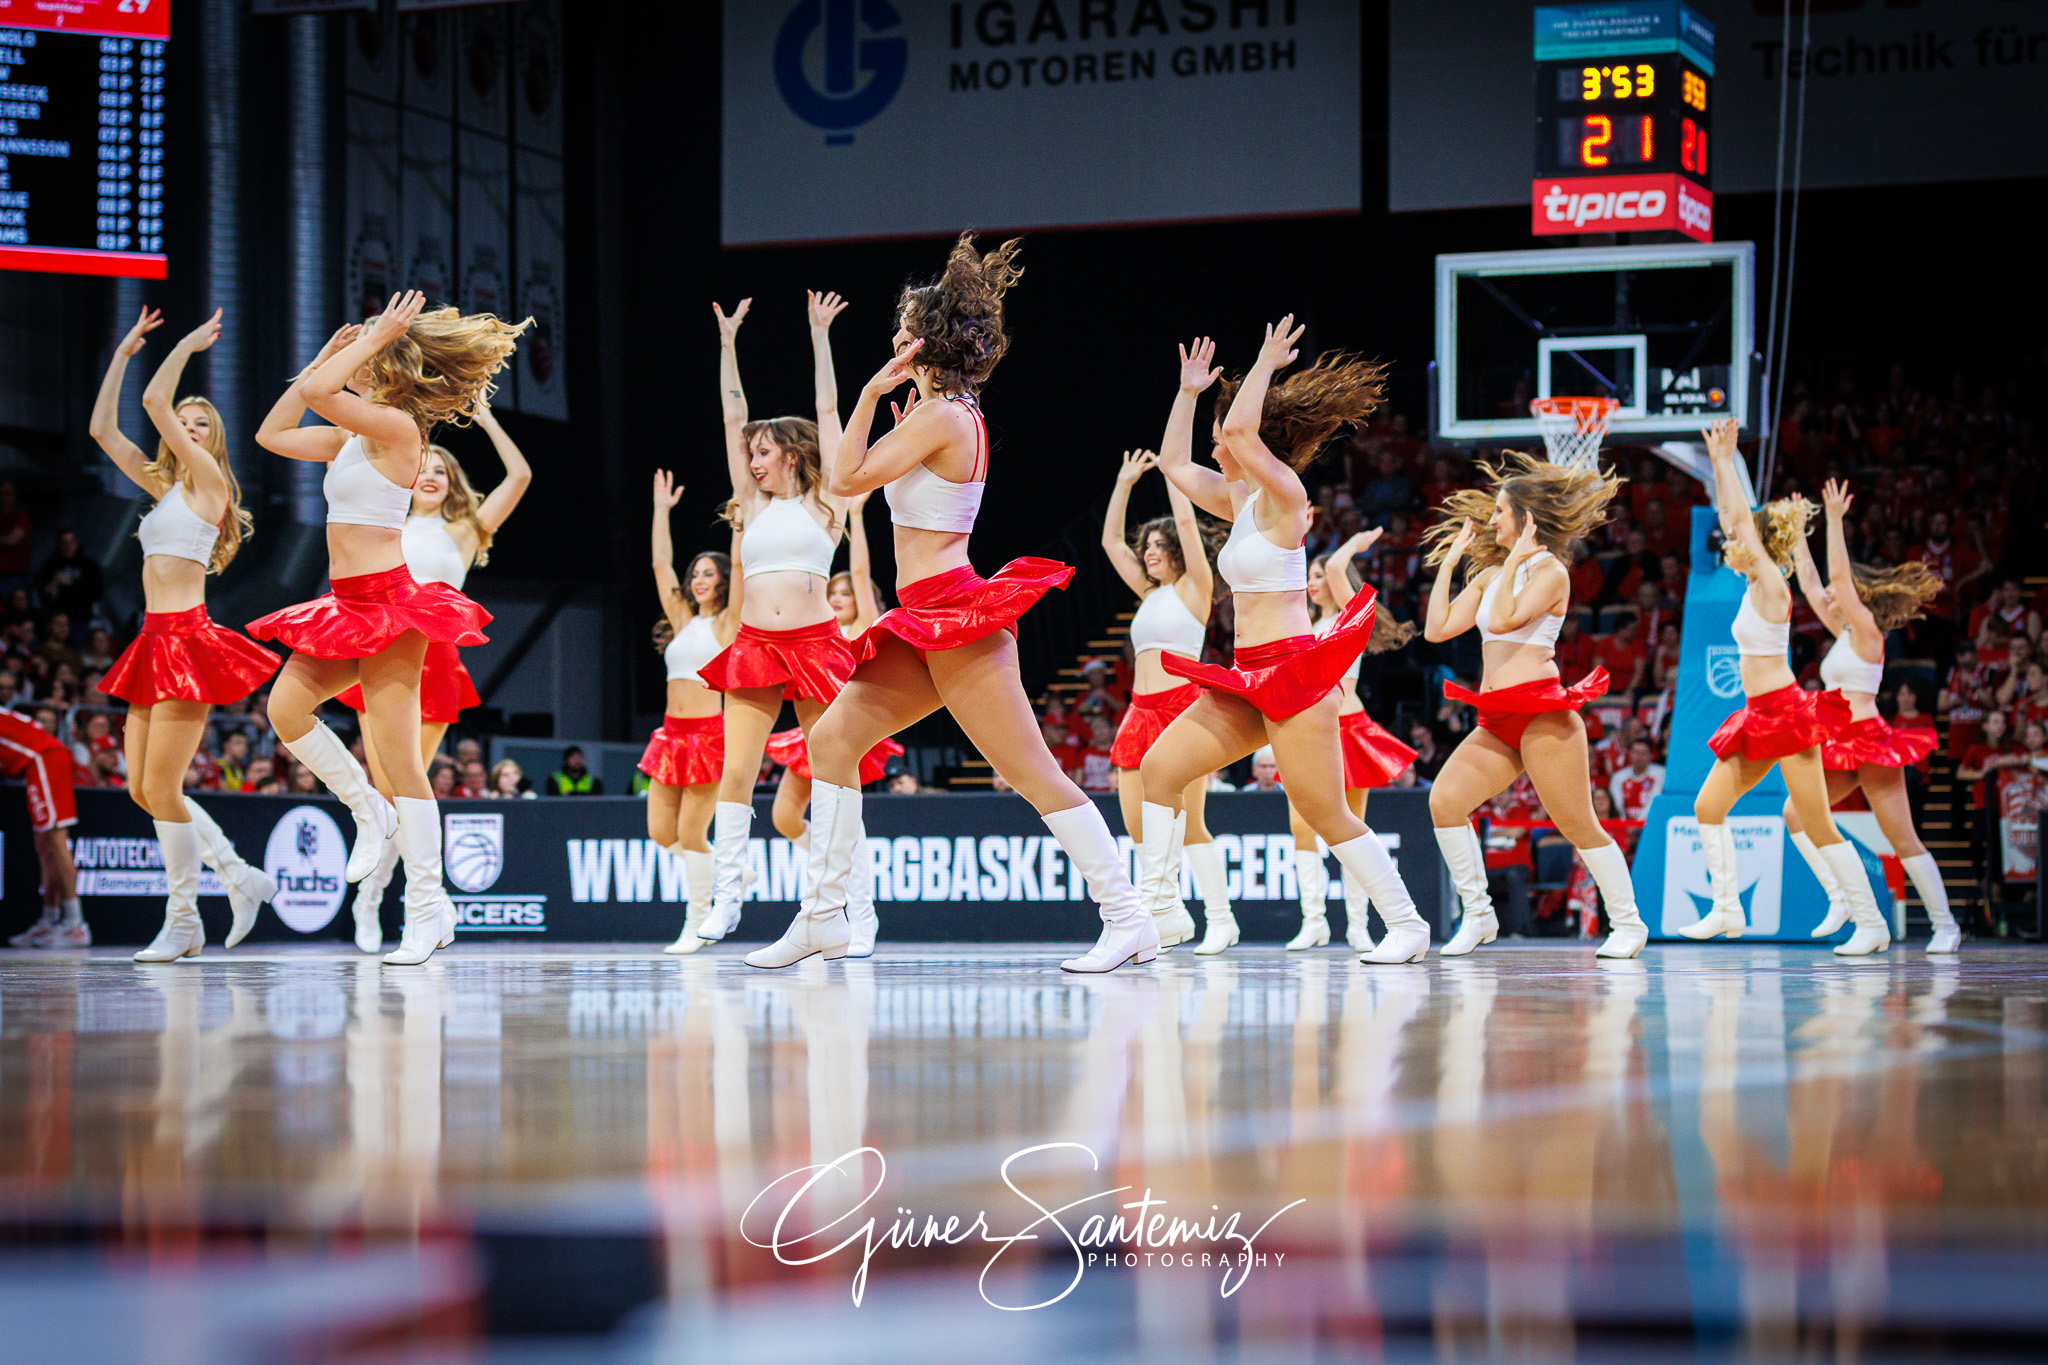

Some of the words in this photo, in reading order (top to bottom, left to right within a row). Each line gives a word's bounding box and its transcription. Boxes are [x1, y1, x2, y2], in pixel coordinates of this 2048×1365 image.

[950, 0, 1295, 48] IGARASHI
[950, 50, 1155, 91] MOTOREN
[1171, 39, 1295, 76] GMBH
[1752, 31, 1953, 78] Technik
[1543, 185, 1667, 227] tipico
